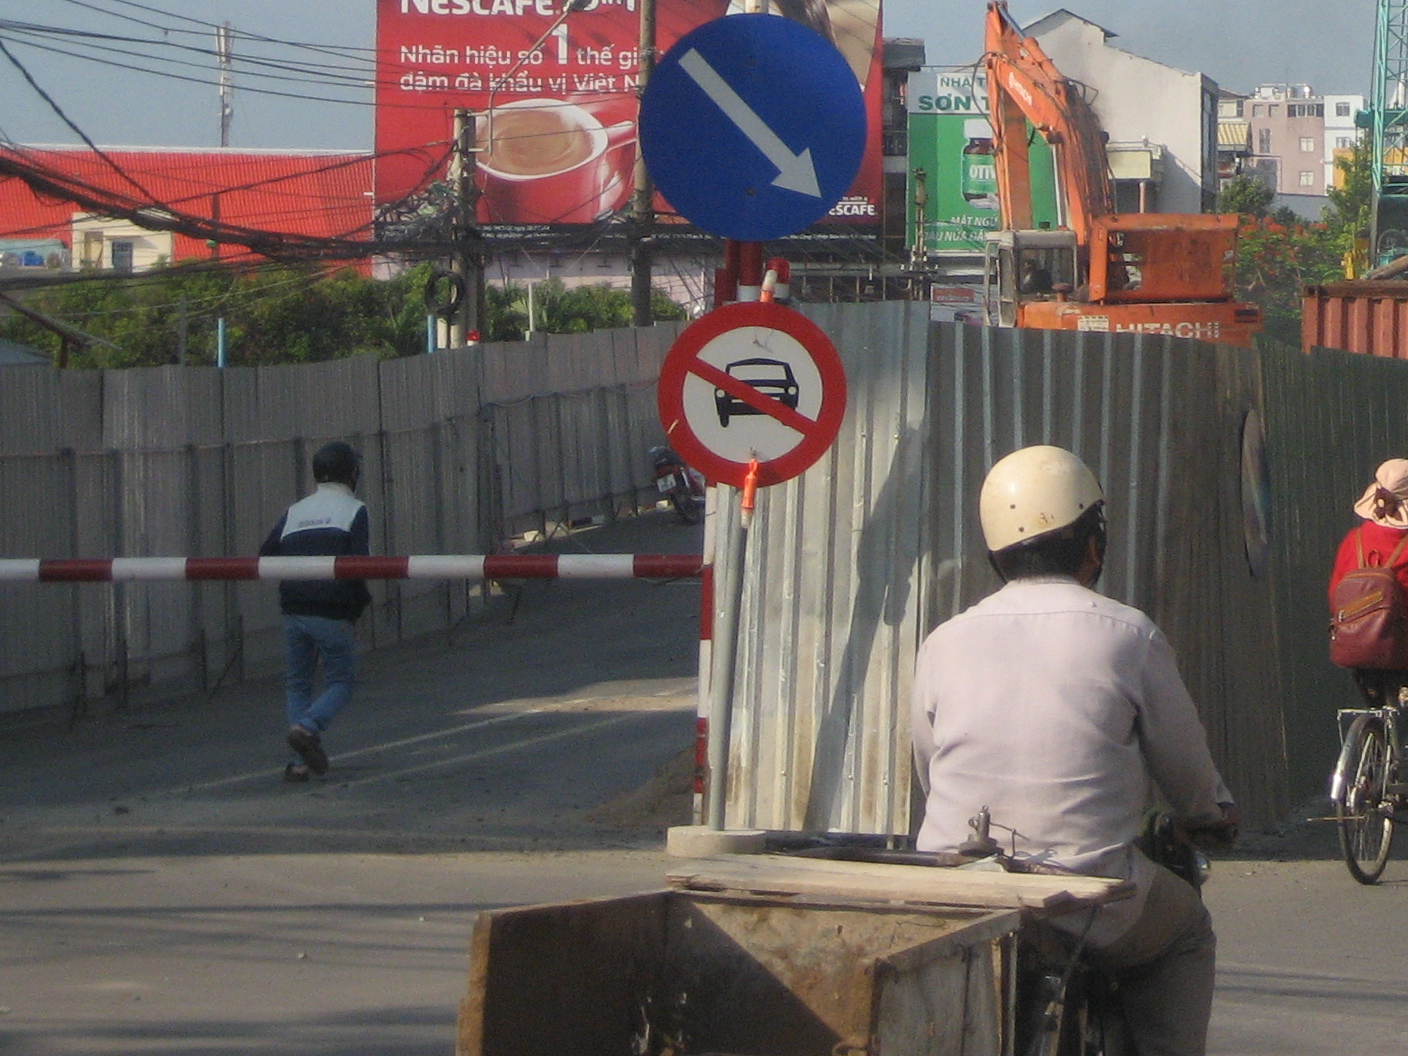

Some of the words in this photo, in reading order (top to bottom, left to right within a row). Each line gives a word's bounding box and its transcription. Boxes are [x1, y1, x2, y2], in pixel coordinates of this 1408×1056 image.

[400, 45, 459, 65] Nhãn
[466, 45, 511, 70] hiệu
[551, 23, 568, 65] 1
[576, 43, 615, 65] thế
[548, 73, 567, 95] vị
[919, 93, 971, 111] SƠN
[1115, 321, 1220, 340] HITACHI
